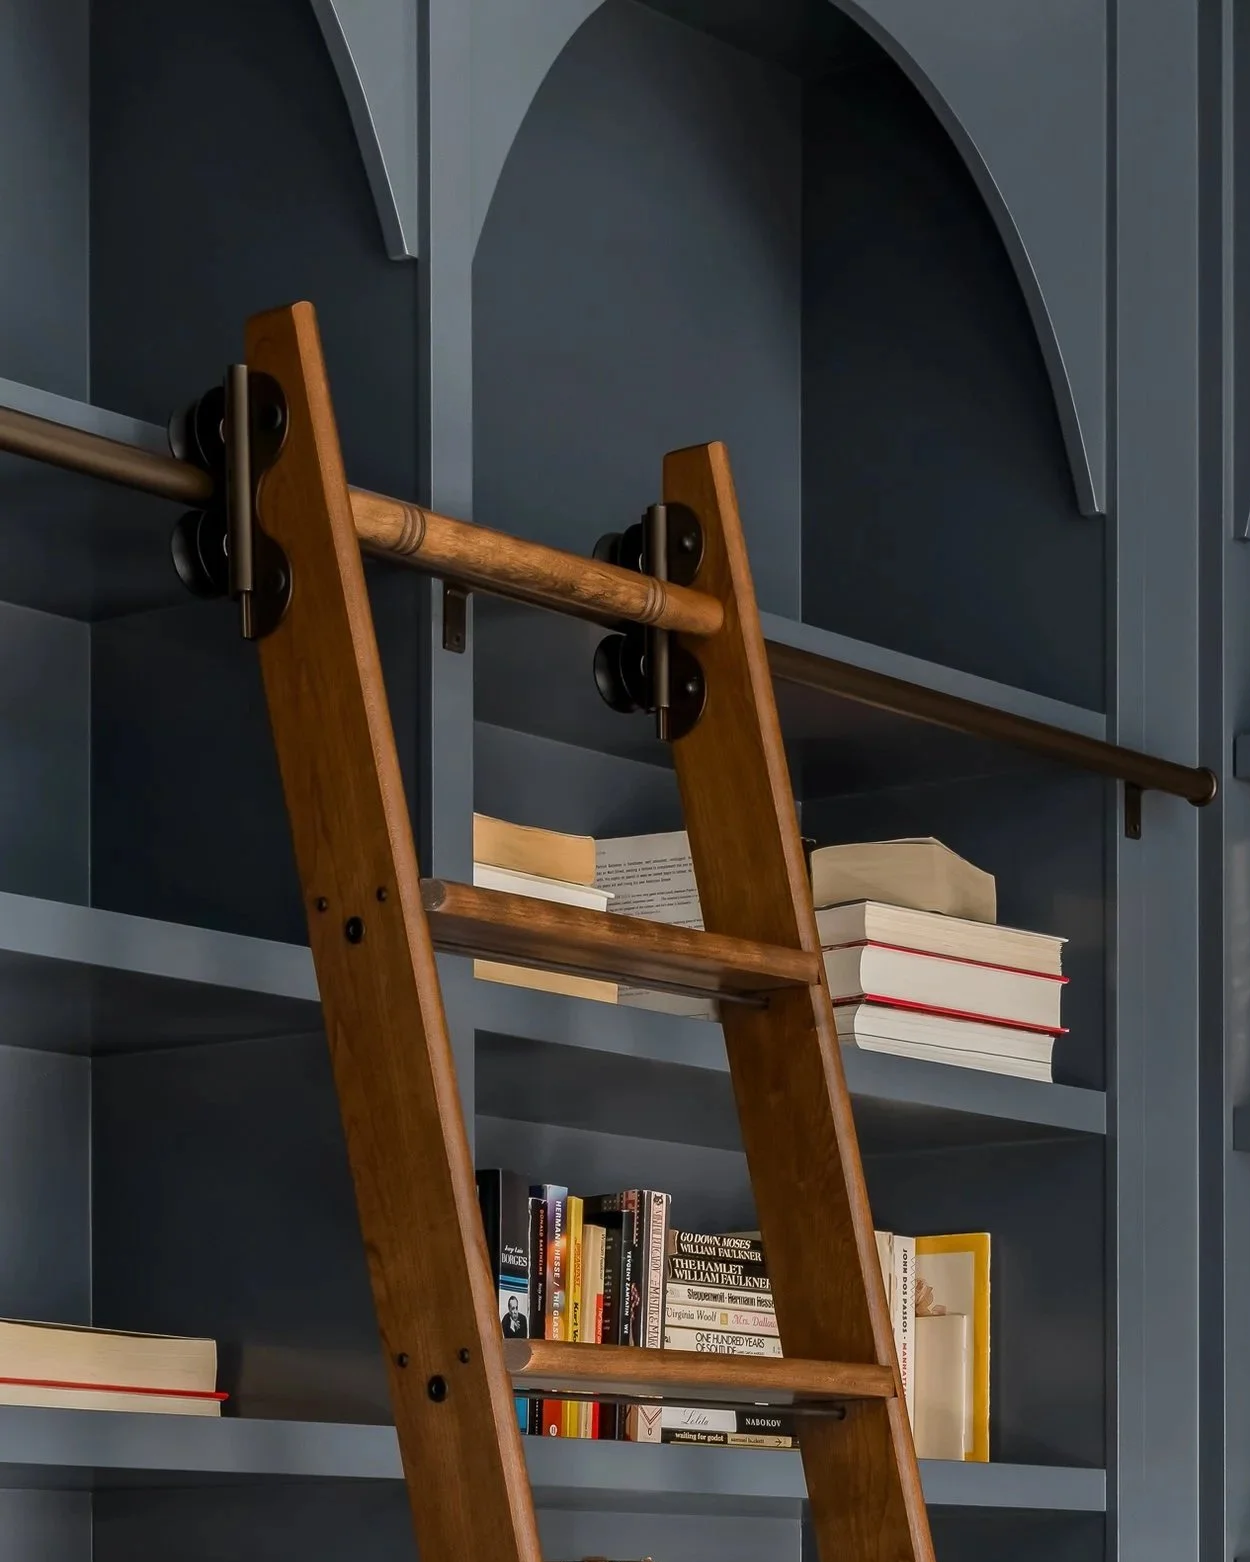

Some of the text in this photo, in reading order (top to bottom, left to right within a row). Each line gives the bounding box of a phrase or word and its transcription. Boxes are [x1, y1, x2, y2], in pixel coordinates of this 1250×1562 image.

[680, 1231, 693, 1242] GO
[722, 1237, 751, 1249] MOSES
[501, 1252, 528, 1267] BORGES
[680, 1243, 762, 1261] WILLIAM FAULKNER
[553, 1250, 561, 1278] HESSE
[673, 1257, 744, 1275] THE HAMLET
[674, 1269, 719, 1283] WILLIAM
[727, 1293, 756, 1307] Hermann
[666, 1307, 694, 1320] Virginia
[696, 1310, 717, 1322] Woolf
[552, 1310, 560, 1339] GLASS
[695, 1332, 765, 1349] ONE HUNDRED YEARS
[695, 1343, 707, 1352] OF
[681, 1409, 711, 1426] Lolita
[745, 1418, 782, 1427] NABOKOV
[675, 1432, 724, 1442] waiting for godot
